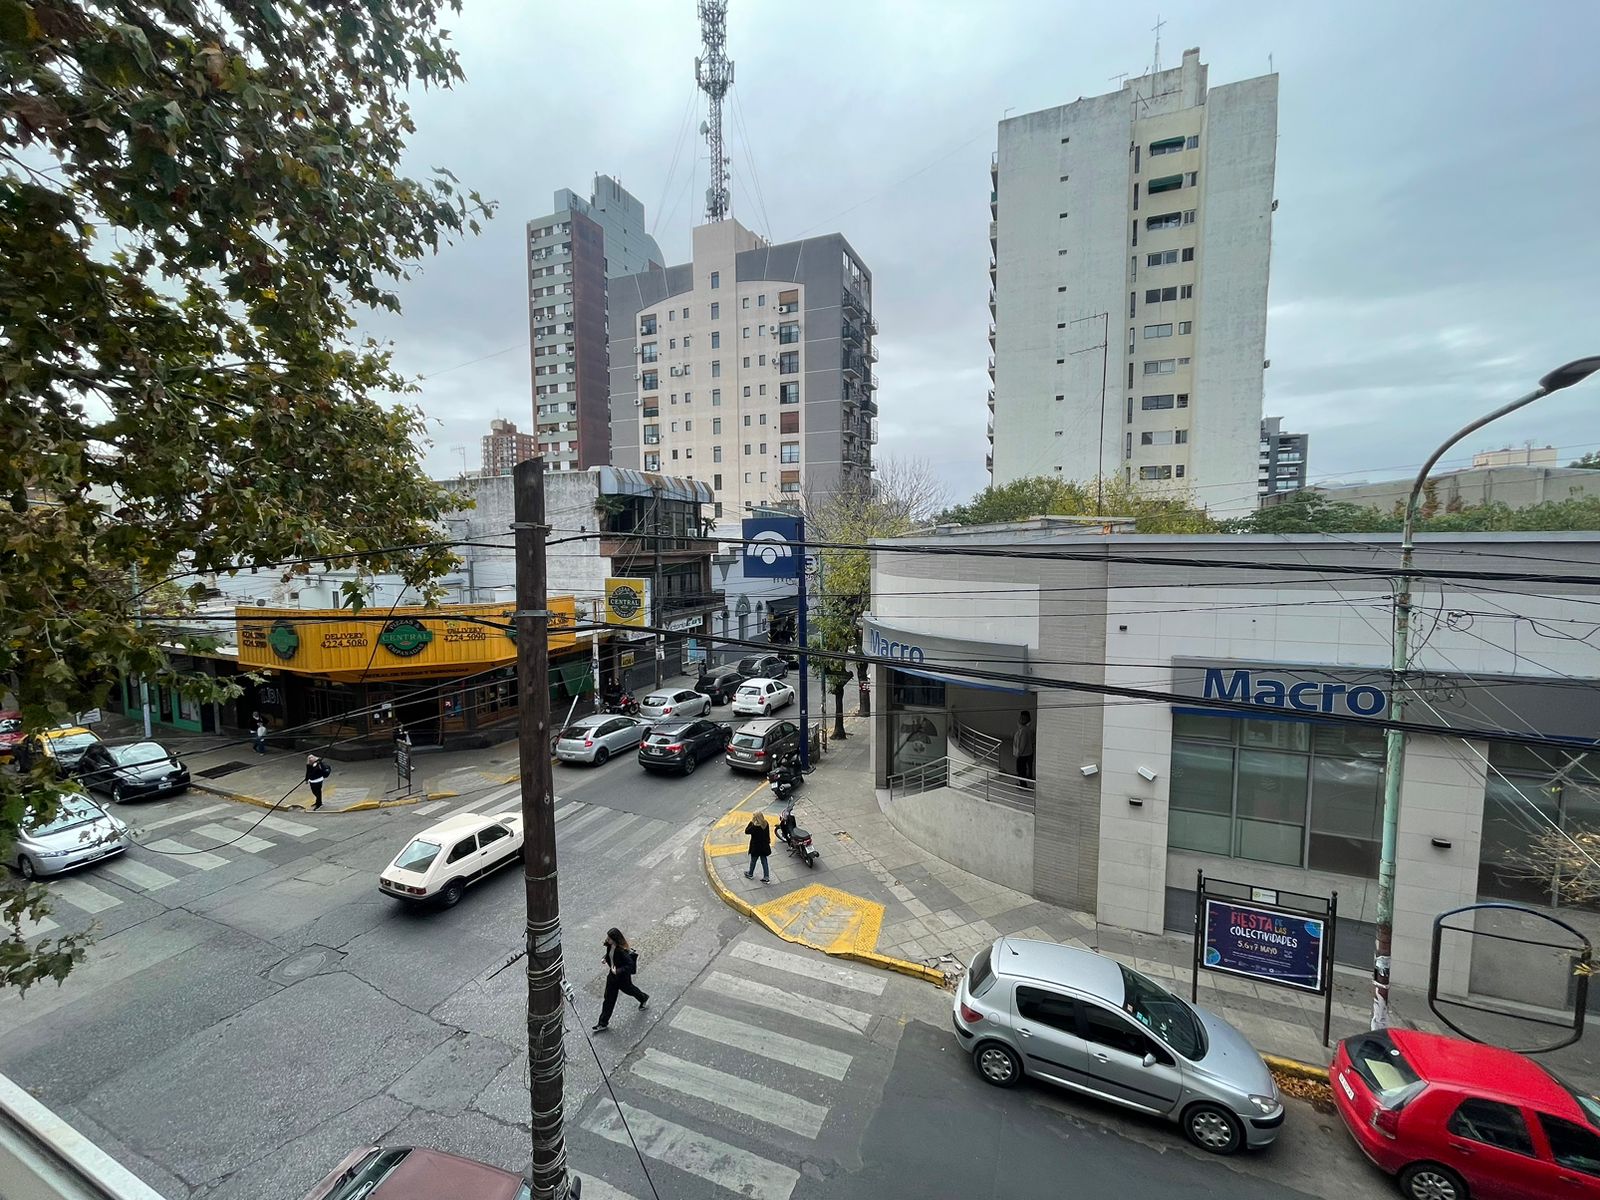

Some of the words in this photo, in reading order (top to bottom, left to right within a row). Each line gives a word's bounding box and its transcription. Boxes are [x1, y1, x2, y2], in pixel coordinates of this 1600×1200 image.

[610, 598, 640, 606] CENTRAL
[388, 619, 414, 630] PIZZAS
[324, 632, 365, 640] DELIVERY
[381, 633, 430, 642] CENTRAL
[387, 643, 424, 656] EMPANADAS
[870, 628, 925, 663] Macro
[1203, 668, 1386, 716] Macro
[1231, 911, 1273, 932] FIESTA
[1230, 926, 1298, 949] COLECTIVIDADES
[1260, 945, 1278, 956] MAYO
